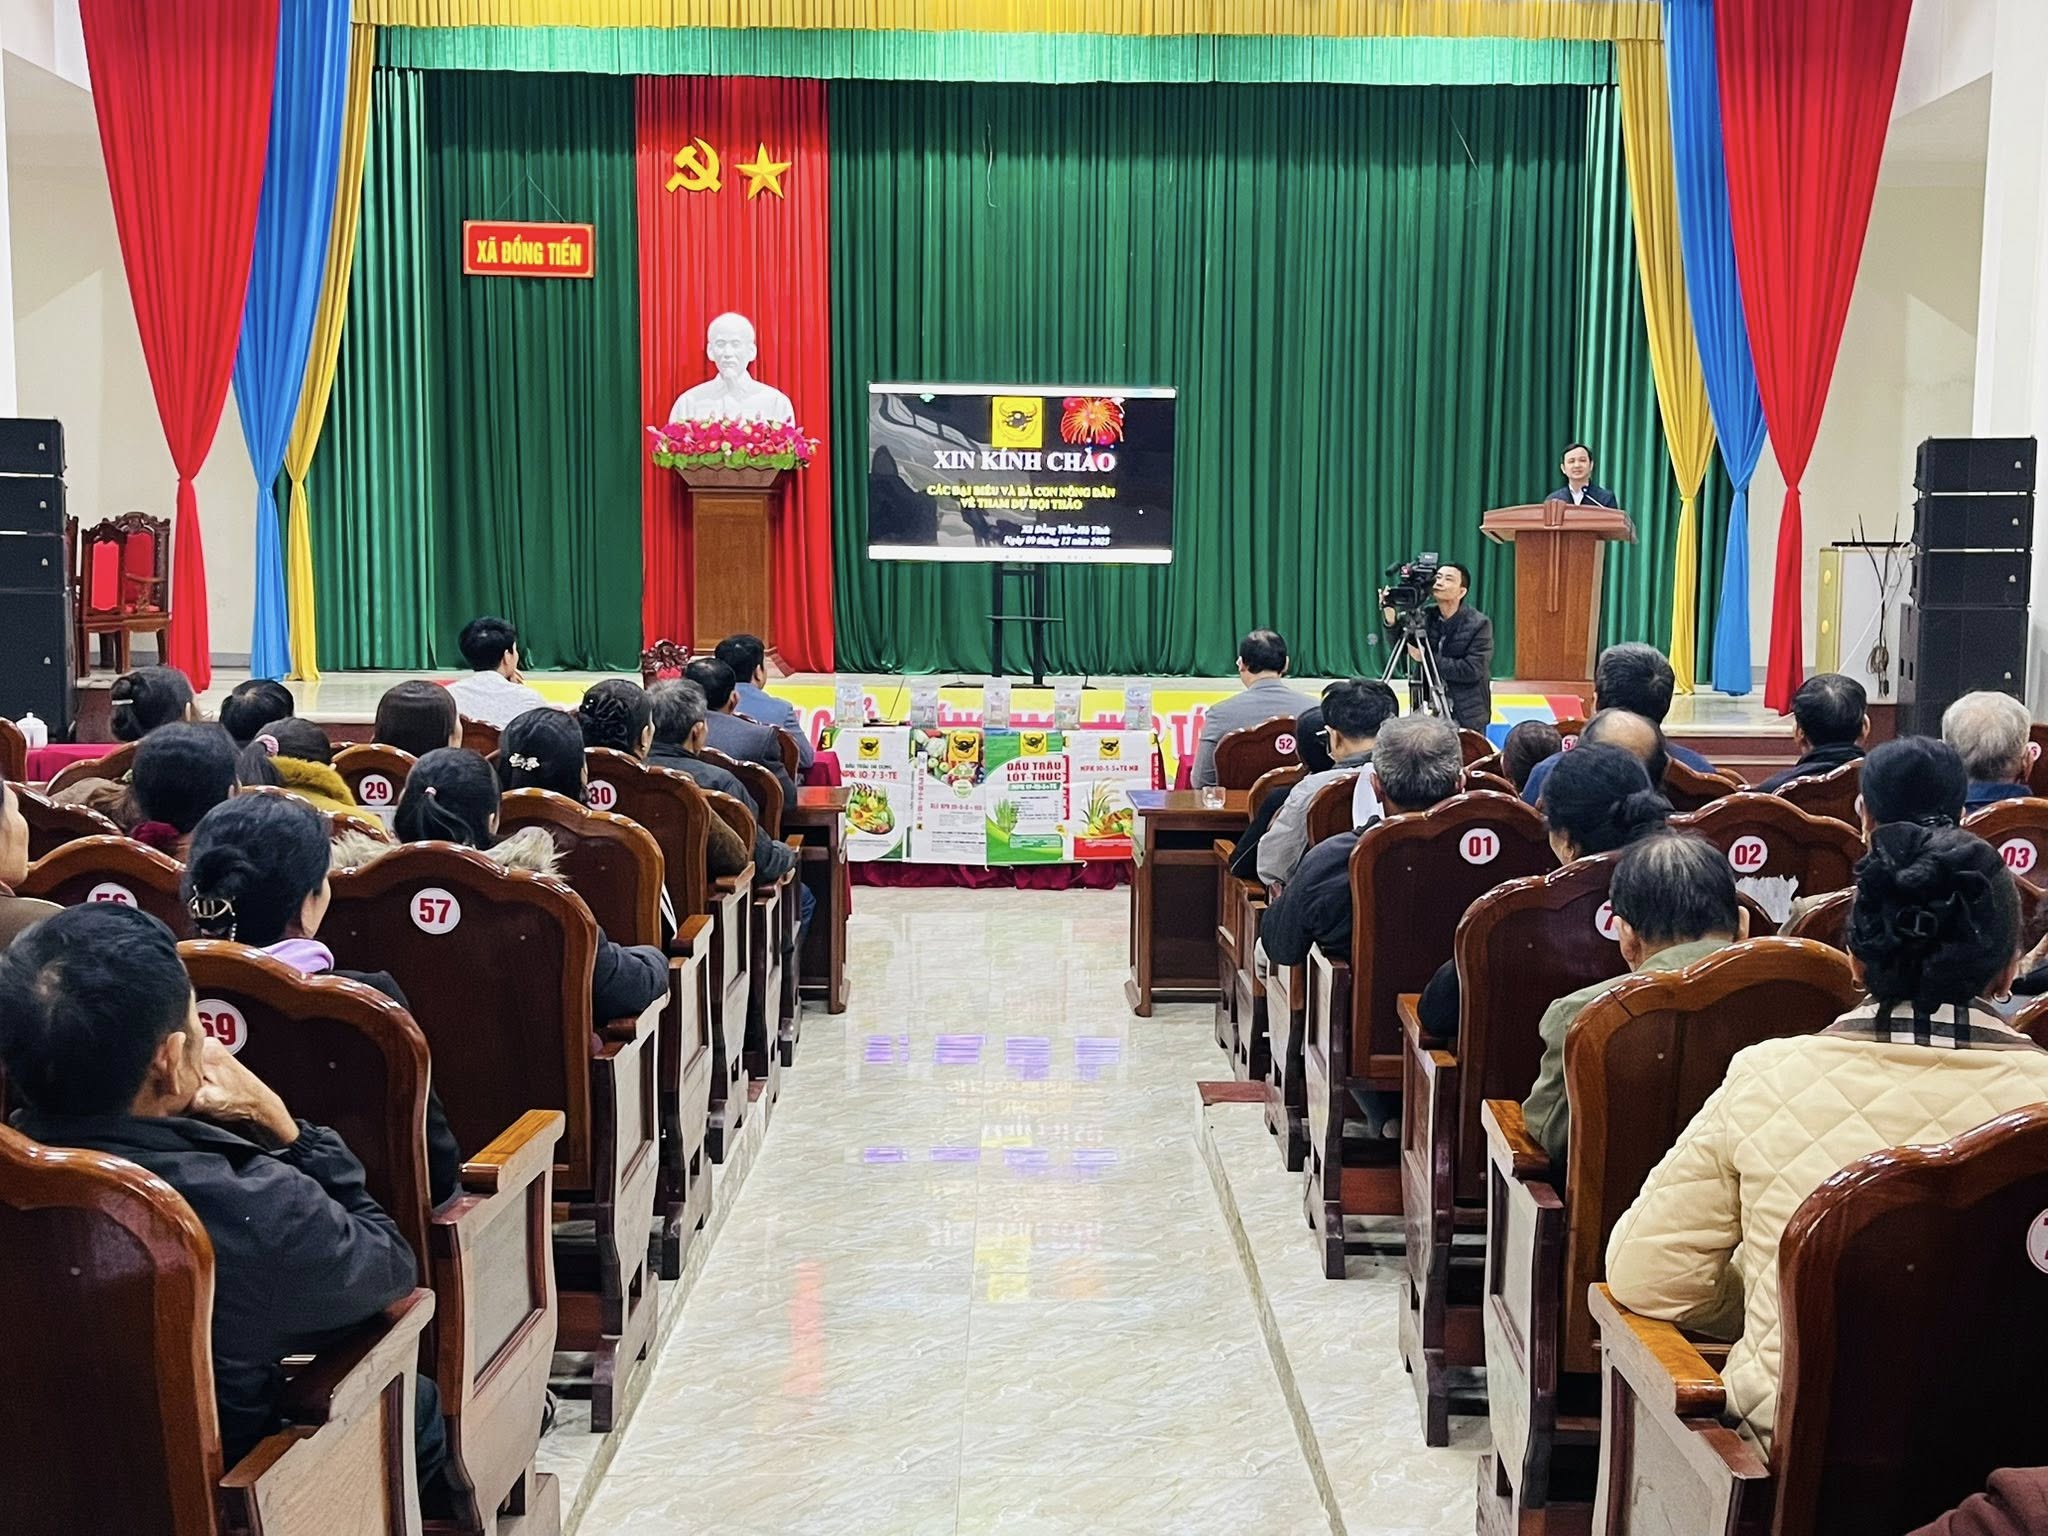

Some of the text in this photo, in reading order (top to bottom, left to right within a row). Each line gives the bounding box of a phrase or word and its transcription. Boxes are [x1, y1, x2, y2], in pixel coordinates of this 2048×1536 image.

[477, 236, 499, 264] XÃ
[547, 236, 582, 267] TIẾN
[933, 447, 1116, 472] XIN KÍNH CHÀO
[1000, 484, 1017, 497] VÀ
[1033, 486, 1058, 498] CON
[1059, 485, 1091, 498] NÔNG
[1279, 738, 1293, 750] 52
[365, 781, 387, 799] 29
[590, 786, 611, 804] 30
[1469, 836, 1491, 857] 01
[1735, 843, 1761, 865] 02
[2003, 846, 2030, 868] 03
[420, 897, 451, 923] 57
